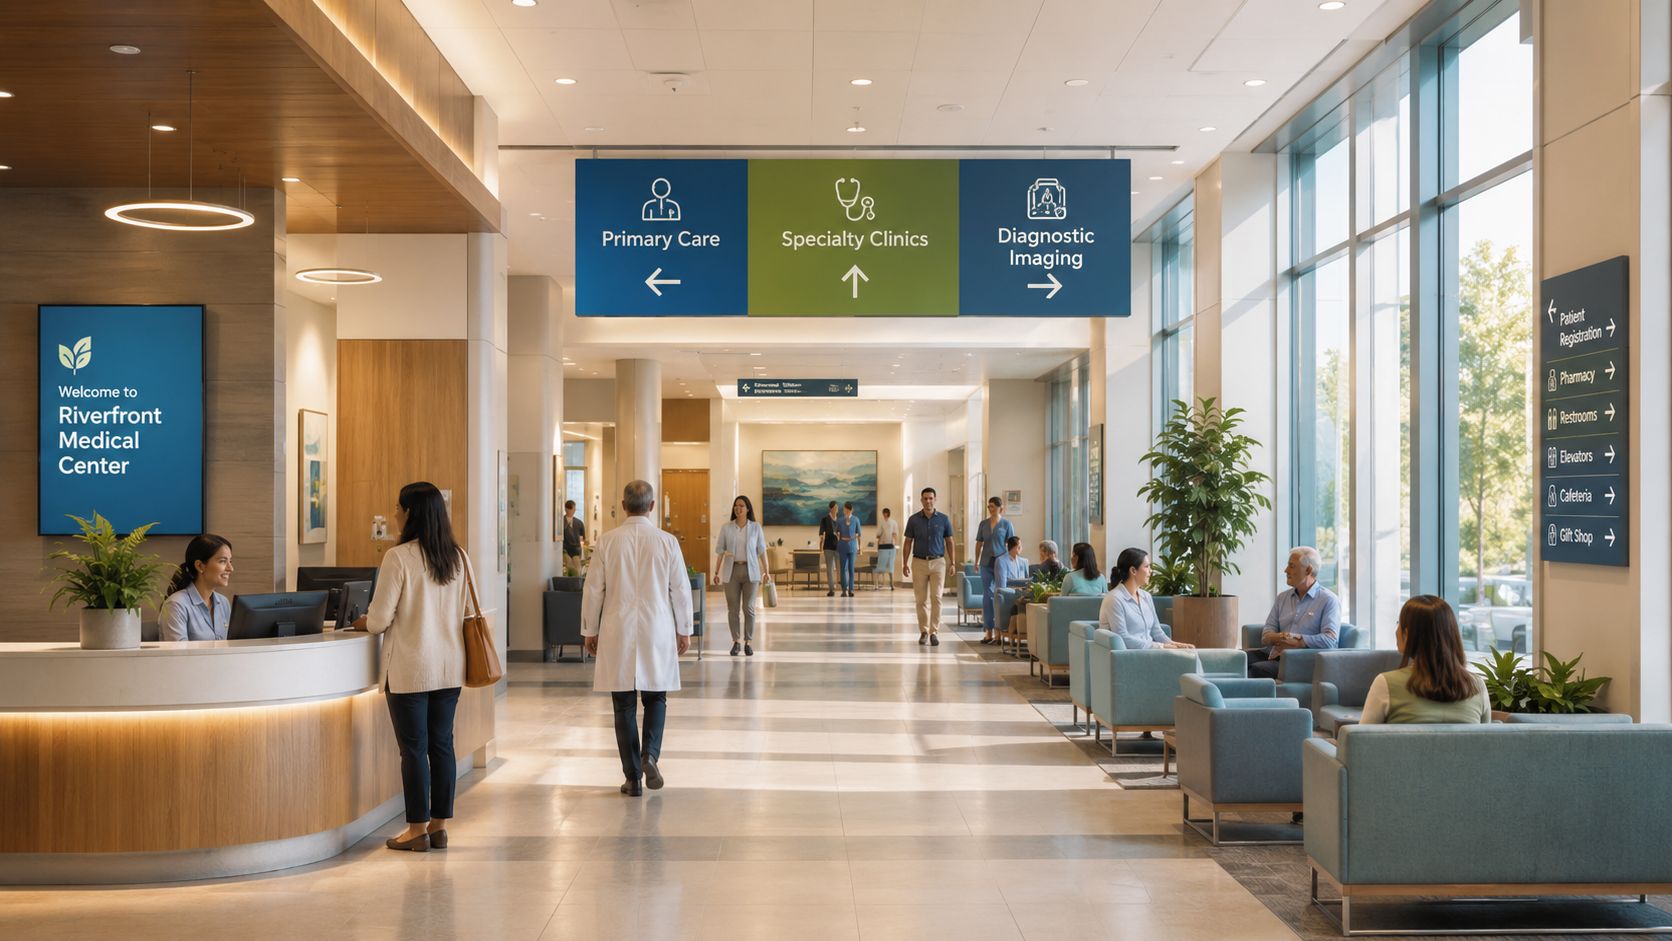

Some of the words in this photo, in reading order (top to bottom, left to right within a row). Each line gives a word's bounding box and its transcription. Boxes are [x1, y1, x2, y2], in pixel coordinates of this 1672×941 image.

[602, 230, 673, 251] Primary
[677, 230, 721, 248] Care
[782, 230, 864, 251] Specialty
[869, 230, 929, 248] Clinics
[998, 227, 1095, 247] Diagnostic
[1010, 249, 1083, 270] Imaging
[1560, 308, 1586, 326] Patient
[1559, 326, 1603, 348] Registration
[1560, 369, 1596, 386] Pharmacy
[58, 385, 120, 398] Welcome
[123, 386, 138, 398] to
[59, 405, 162, 425] Riverfront
[1560, 409, 1598, 425] Restrooms
[59, 430, 140, 449] Medical
[58, 455, 130, 475] Center
[1560, 449, 1594, 464] Elevators
[1559, 488, 1593, 503] Cafeteria
[1559, 527, 1574, 543] Gift
[1574, 528, 1594, 547] Shop
